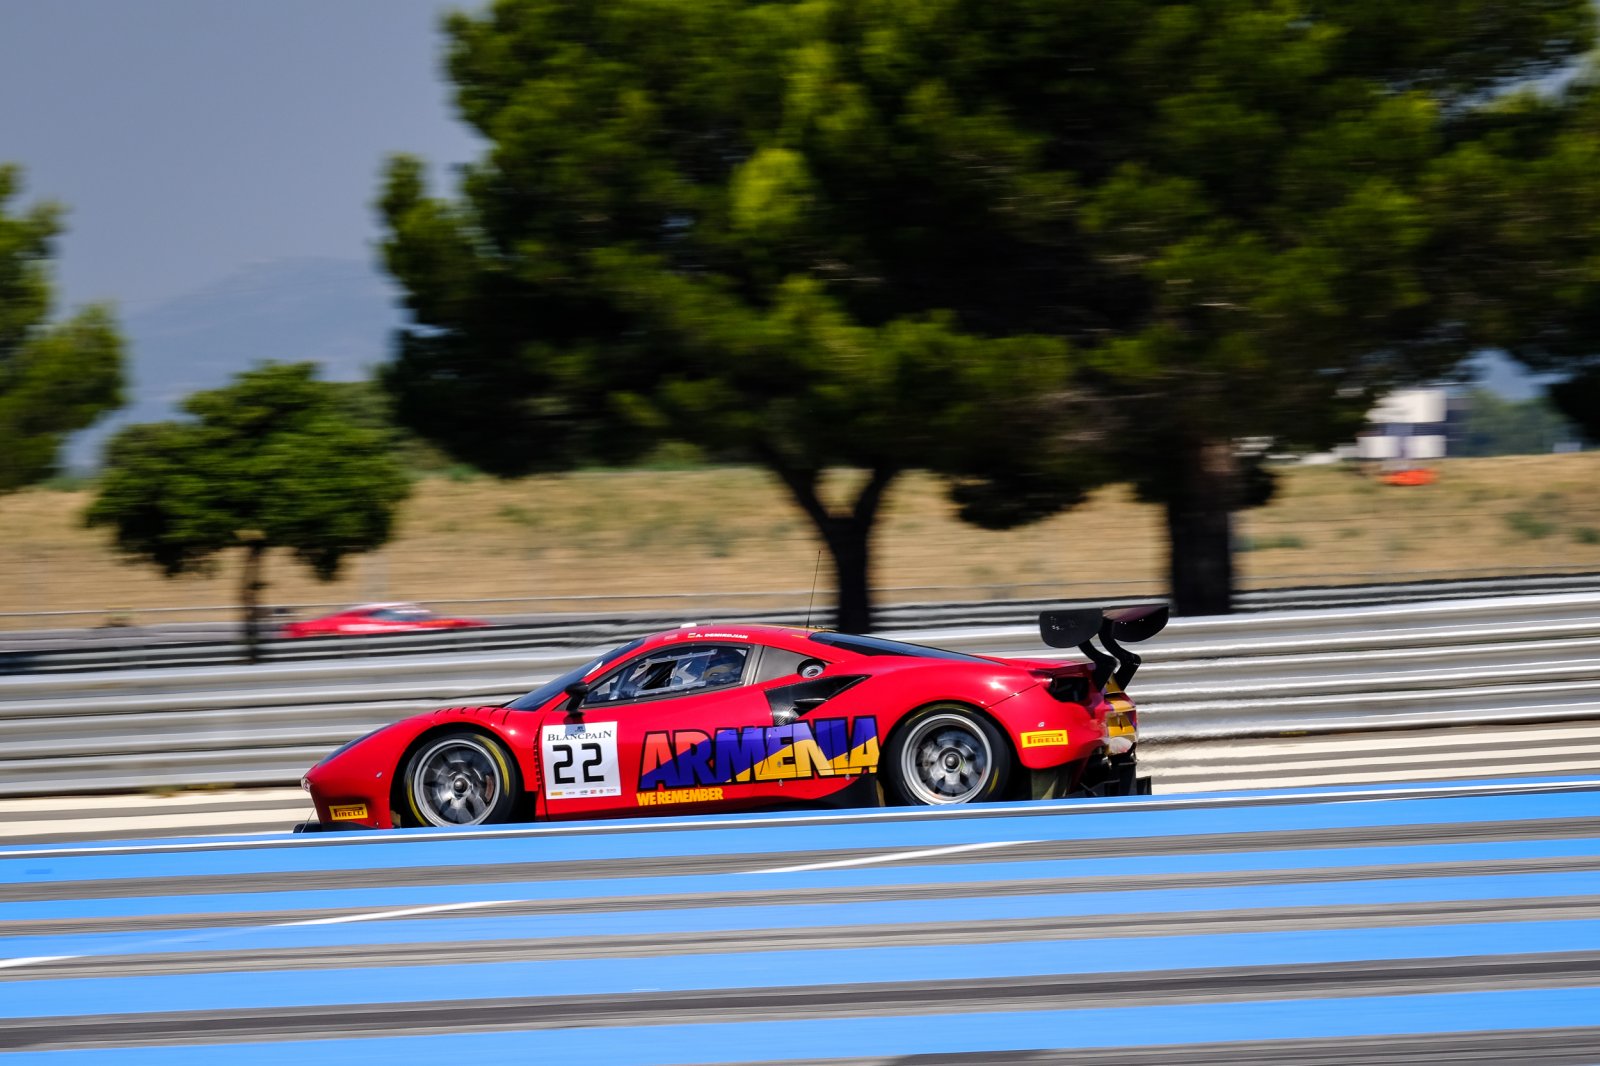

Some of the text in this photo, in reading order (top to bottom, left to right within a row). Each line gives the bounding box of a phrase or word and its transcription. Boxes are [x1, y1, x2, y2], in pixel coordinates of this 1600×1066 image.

[547, 730, 612, 742] BLANCPAIN
[1026, 733, 1064, 745] PIRELLI
[637, 715, 880, 791] ARMENIA
[552, 743, 605, 784] 22
[636, 787, 723, 806] WE REMEMBER
[333, 807, 364, 817] PIRELLI
